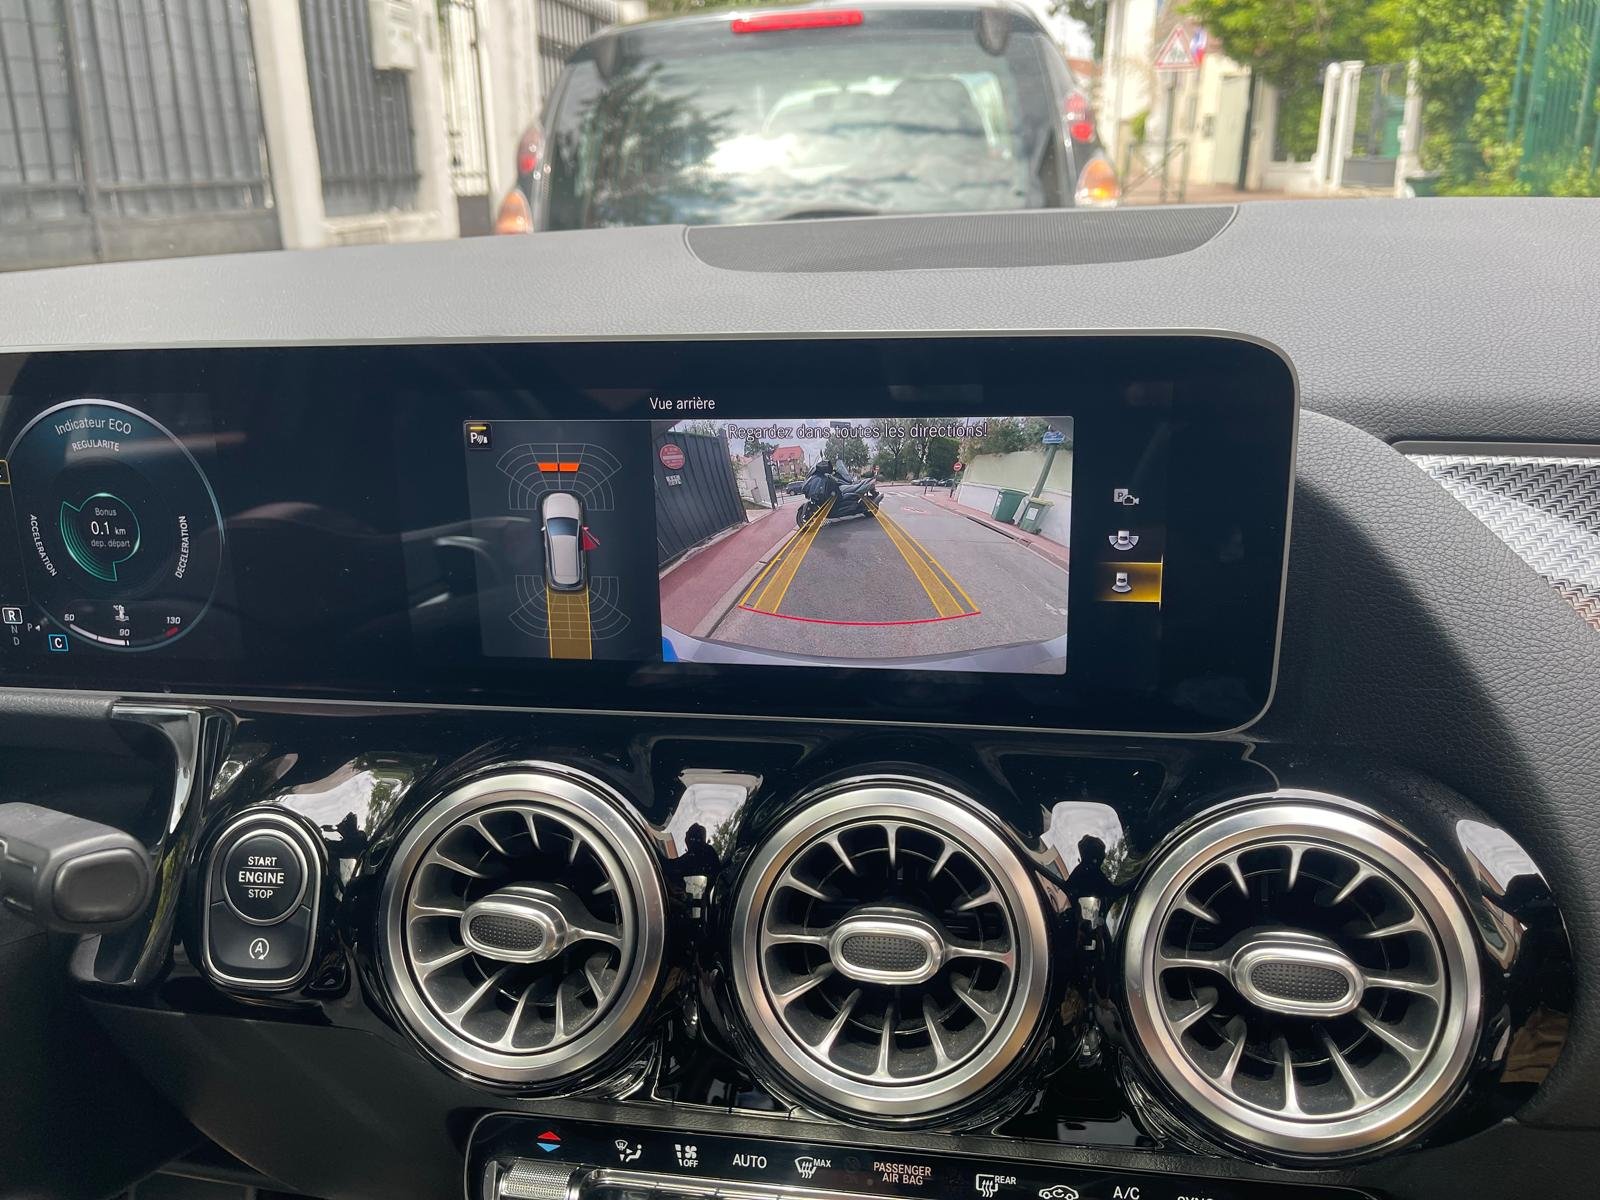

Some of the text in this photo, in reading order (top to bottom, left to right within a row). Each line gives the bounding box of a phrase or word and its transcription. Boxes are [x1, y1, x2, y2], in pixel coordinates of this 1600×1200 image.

[649, 396, 716, 410] Vue arrière
[54, 417, 132, 436] Indicateur ECO
[728, 421, 988, 441] Regardez dans toutes les directions!
[71, 439, 120, 452] REGULARITE
[94, 507, 117, 516] Bonus
[90, 520, 127, 535] 0.1 km
[30, 513, 58, 577] ACCELERATION
[91, 538, 131, 549] dep. départ
[174, 515, 190, 579] DECELERATION
[8, 610, 16, 621] R
[166, 616, 181, 624] 130
[11, 624, 18, 634] N
[119, 628, 130, 637] 90
[13, 636, 20, 646] D
[54, 637, 63, 649] C
[247, 855, 278, 867] START
[238, 870, 285, 884] ENGINE
[248, 889, 274, 899] STOP
[683, 1158, 699, 1168] OFF
[732, 1153, 768, 1169] AUTO
[813, 1158, 832, 1168] MAX
[873, 1161, 932, 1177] PASSENGER
[882, 1172, 923, 1186] AIR BAG
[994, 1175, 1017, 1185] REAR
[1112, 1185, 1140, 1200] A/C
